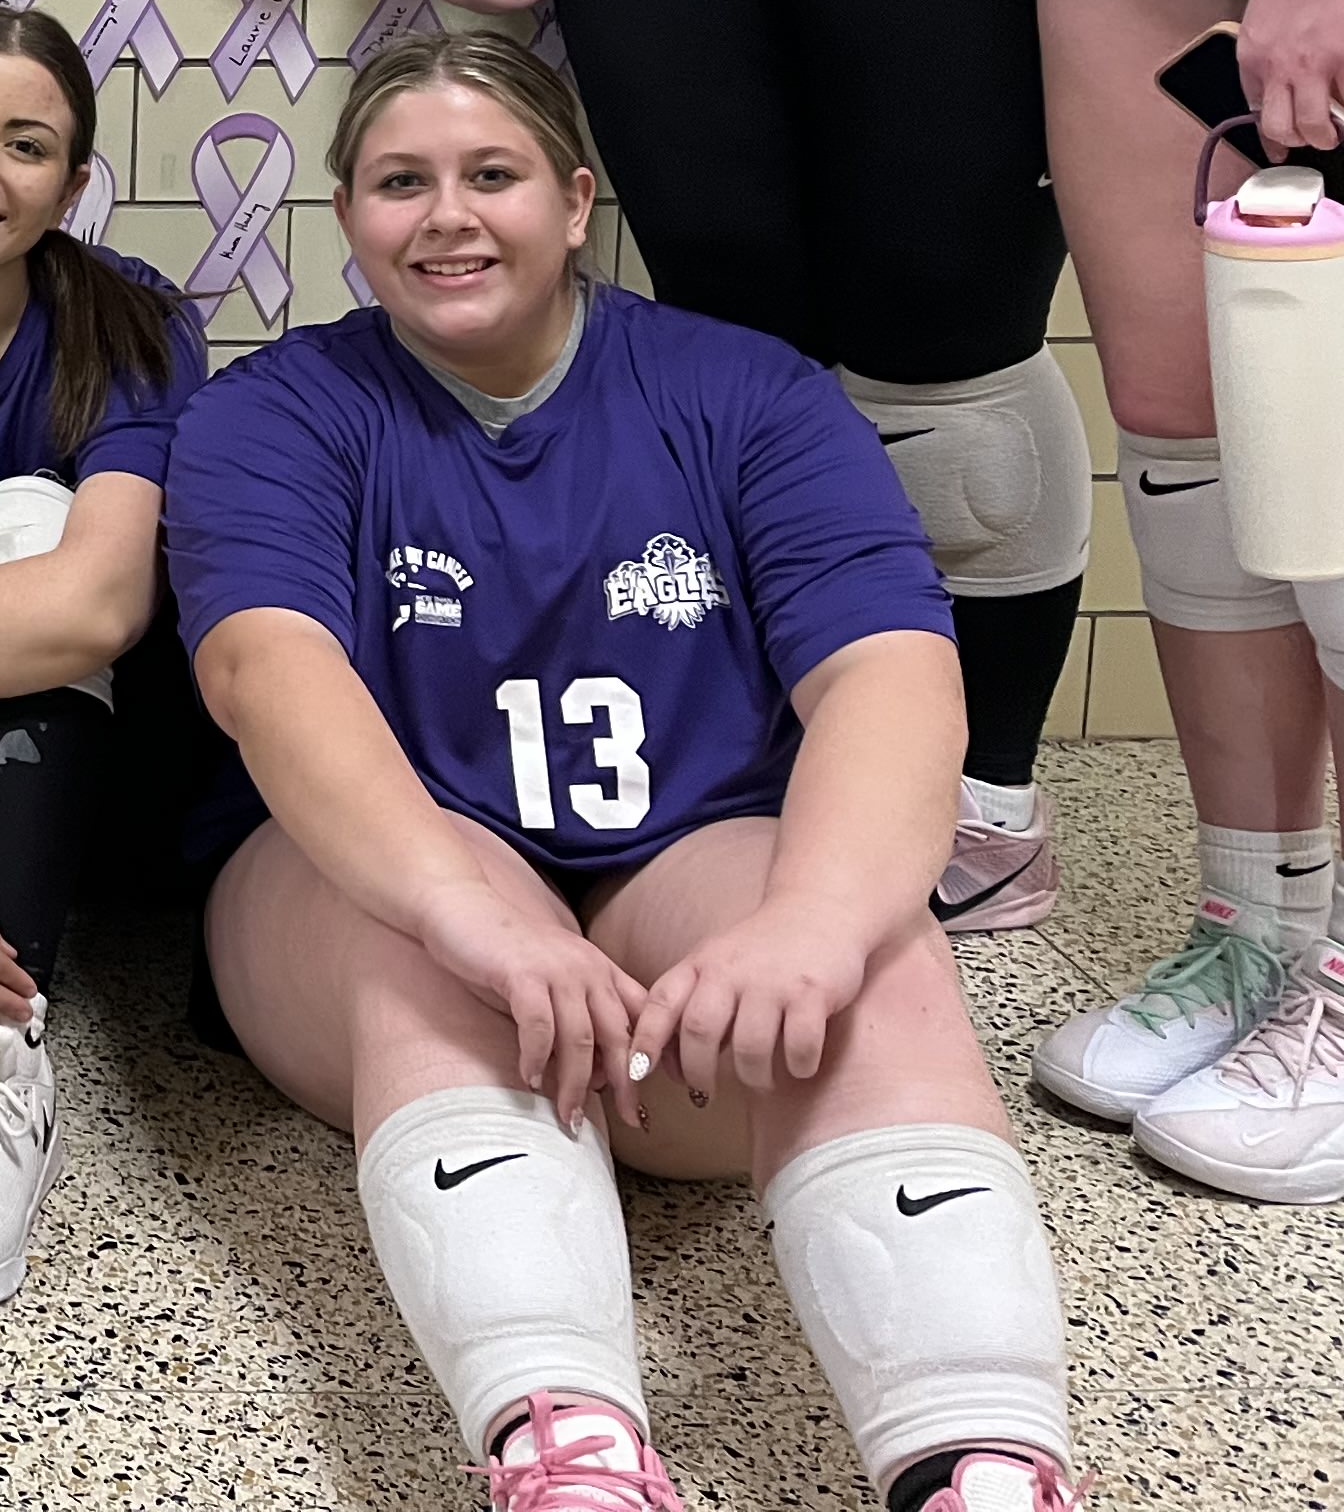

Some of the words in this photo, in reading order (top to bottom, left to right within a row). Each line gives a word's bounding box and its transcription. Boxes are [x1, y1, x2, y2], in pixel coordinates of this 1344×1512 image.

[228, 11, 272, 68] Laurie
[427, 550, 475, 592] CANCER
[604, 571, 730, 620] EAGLES
[415, 601, 462, 617] GAME
[495, 677, 651, 830] 13
